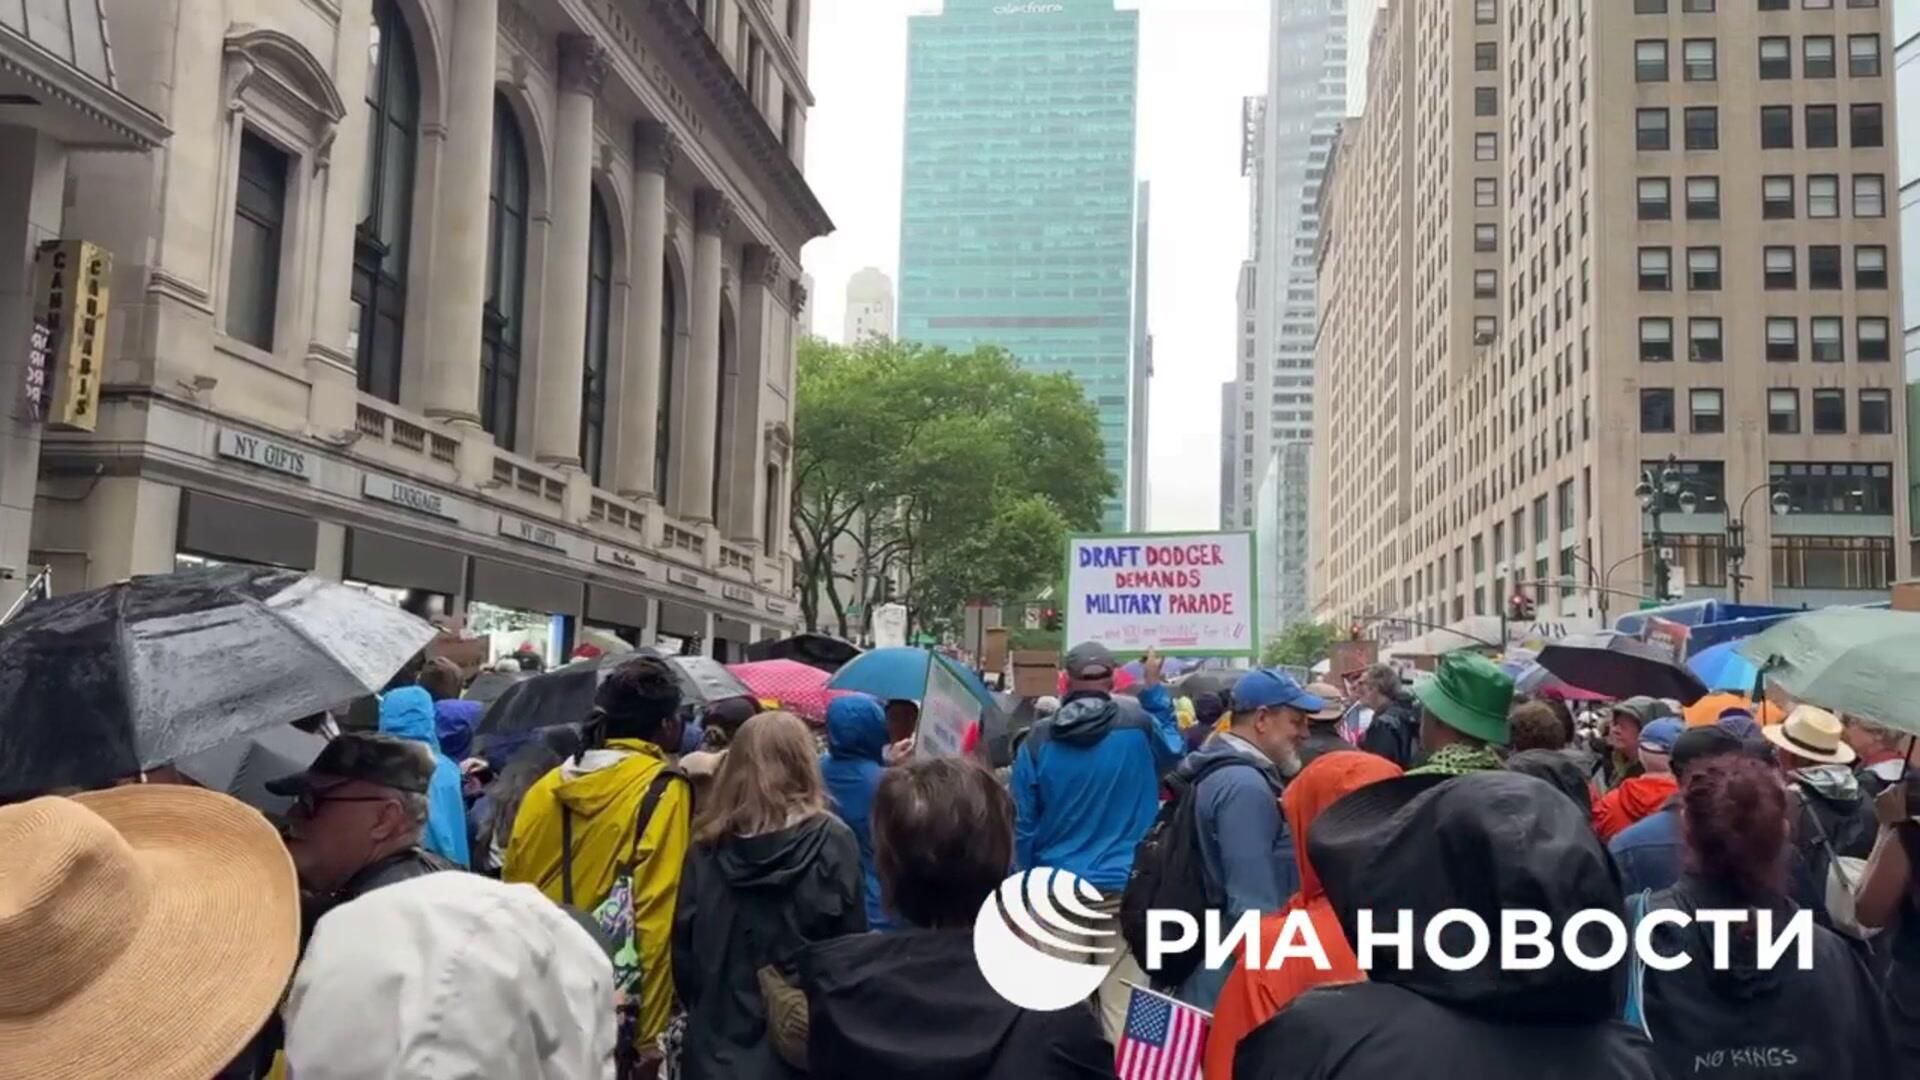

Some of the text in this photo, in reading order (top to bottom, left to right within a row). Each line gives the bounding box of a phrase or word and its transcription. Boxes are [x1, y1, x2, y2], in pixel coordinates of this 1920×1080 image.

[75, 260, 102, 415] CANNABIS
[234, 434, 304, 473] NY GIFTS
[392, 483, 442, 513] LUGGAGE
[1079, 544, 1224, 568] DRAFT DODGER
[1115, 569, 1201, 589] DEMANDS
[1085, 593, 1233, 615] MILITARY PARADE
[1694, 1047, 1798, 1073] NO KINGS
